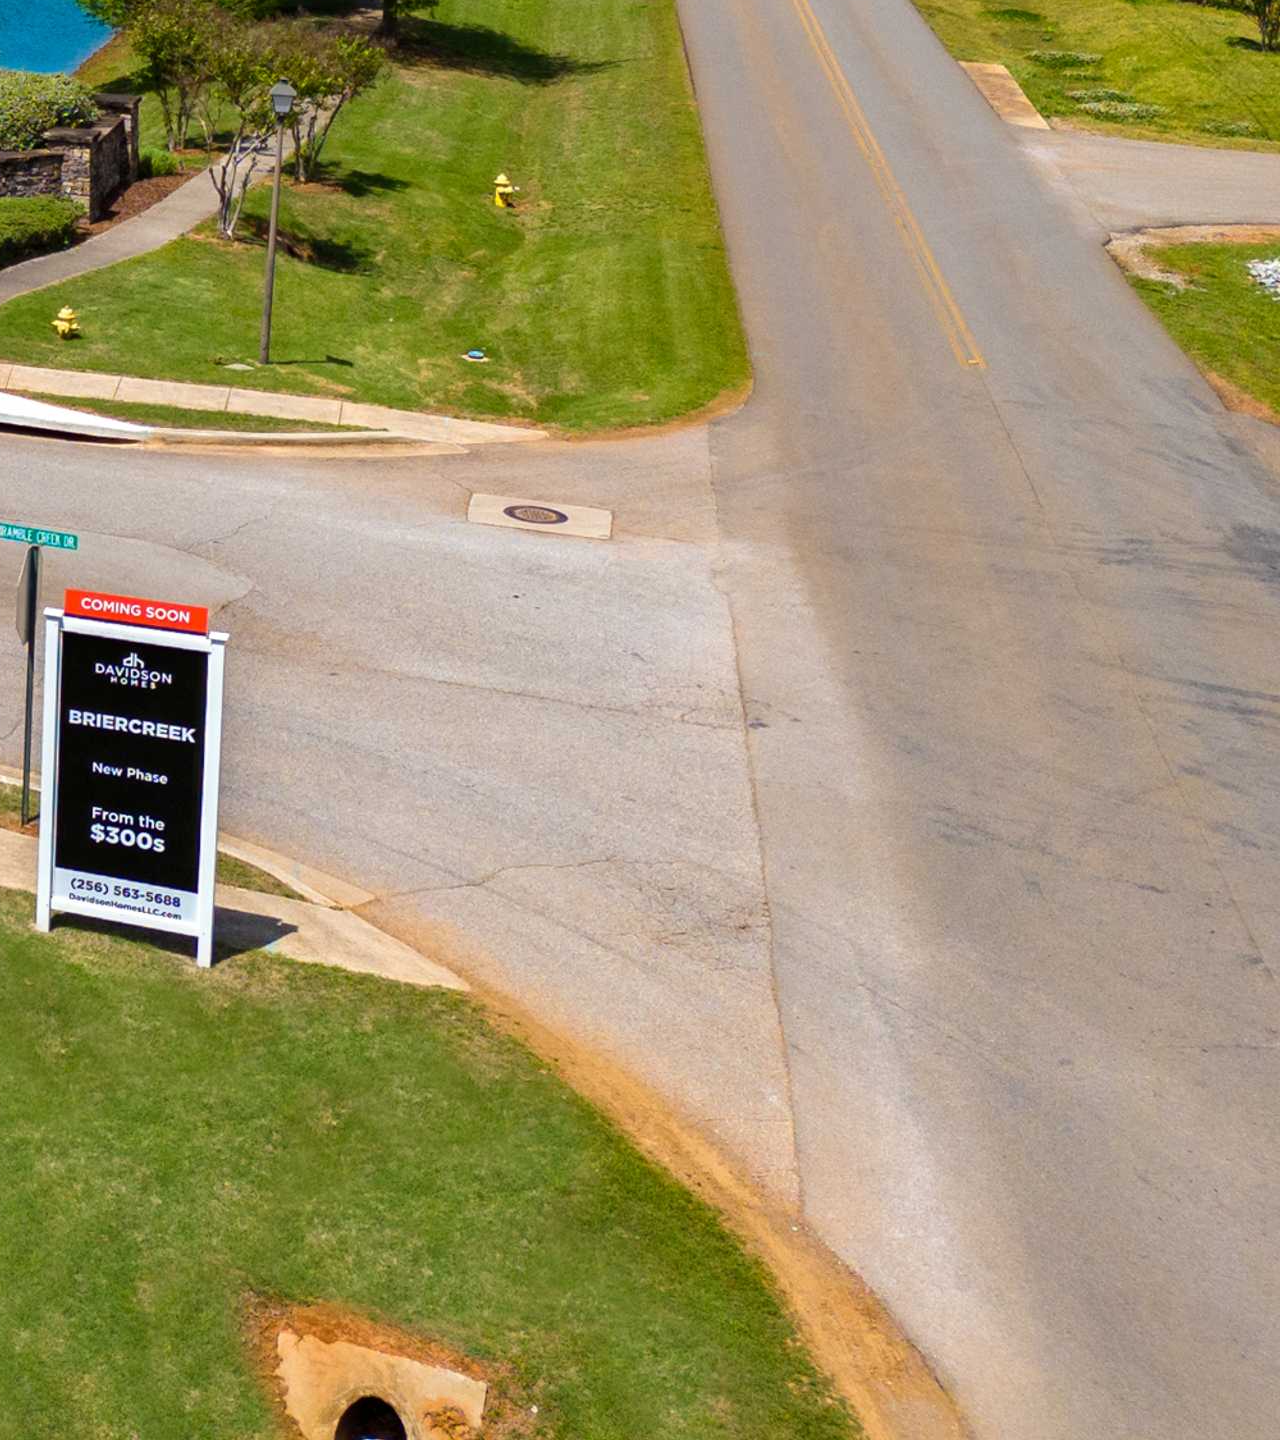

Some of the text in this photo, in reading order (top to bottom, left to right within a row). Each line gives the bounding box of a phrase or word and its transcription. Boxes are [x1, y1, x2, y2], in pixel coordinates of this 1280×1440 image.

[36, 531, 61, 546] CREEK
[80, 597, 190, 624] COMING SOON
[95, 662, 172, 685] DAVIDSON
[110, 676, 157, 690] HOMES
[68, 709, 197, 744] BRIERCREEK
[92, 762, 169, 785] New Phase
[91, 806, 166, 831] From the
[90, 823, 166, 853] $300s
[68, 892, 182, 920] DavidsonHomesLLC.com
[70, 878, 181, 908] (256) 563-5688
